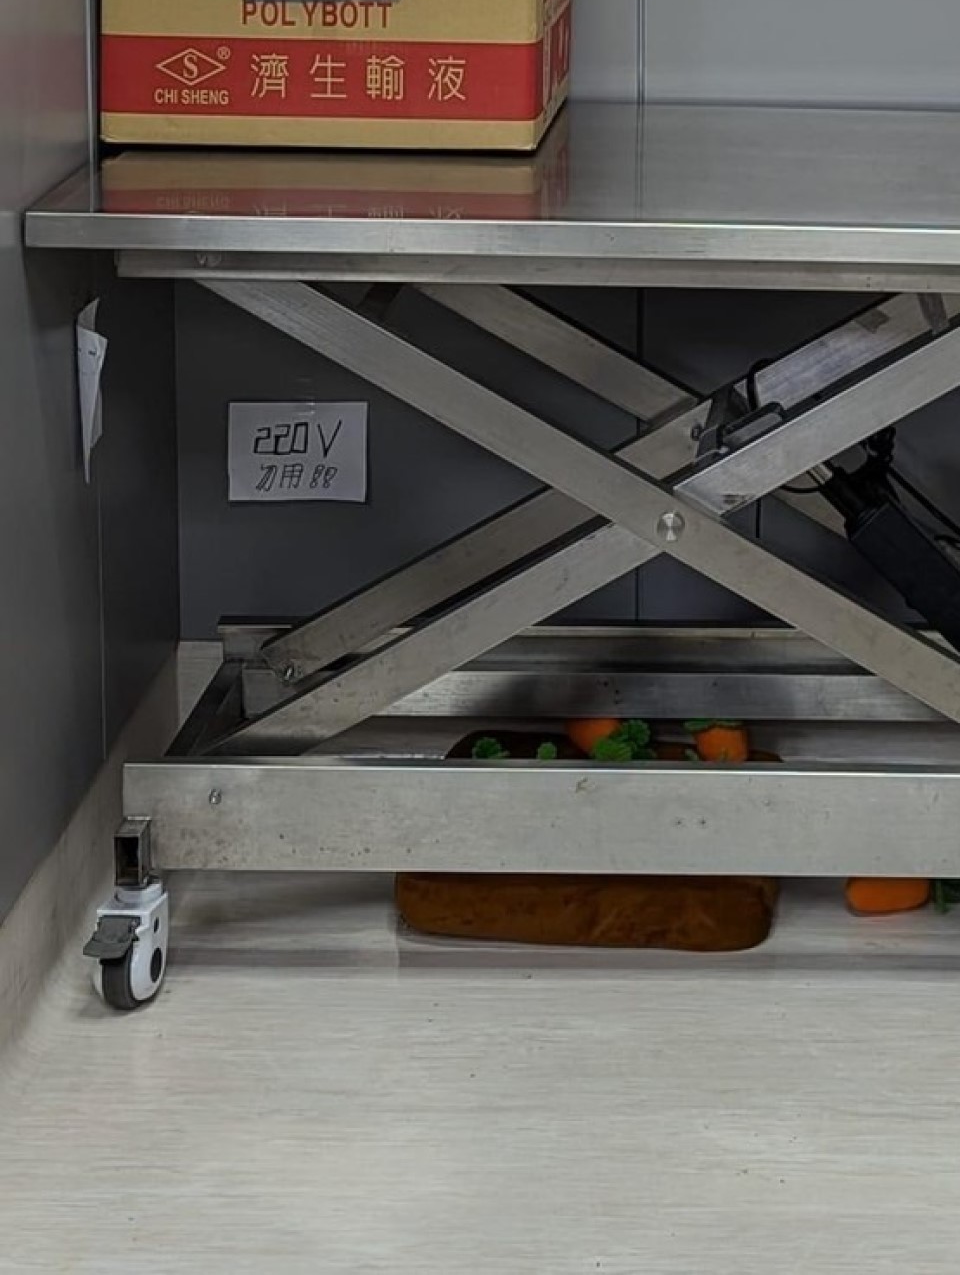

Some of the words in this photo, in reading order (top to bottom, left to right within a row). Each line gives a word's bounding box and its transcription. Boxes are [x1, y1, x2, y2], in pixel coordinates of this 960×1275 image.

[241, 0, 393, 29] POLYBOTT
[250, 53, 468, 102] 濟生輸液
[154, 88, 178, 104] CHI
[181, 88, 229, 106] SHENG
